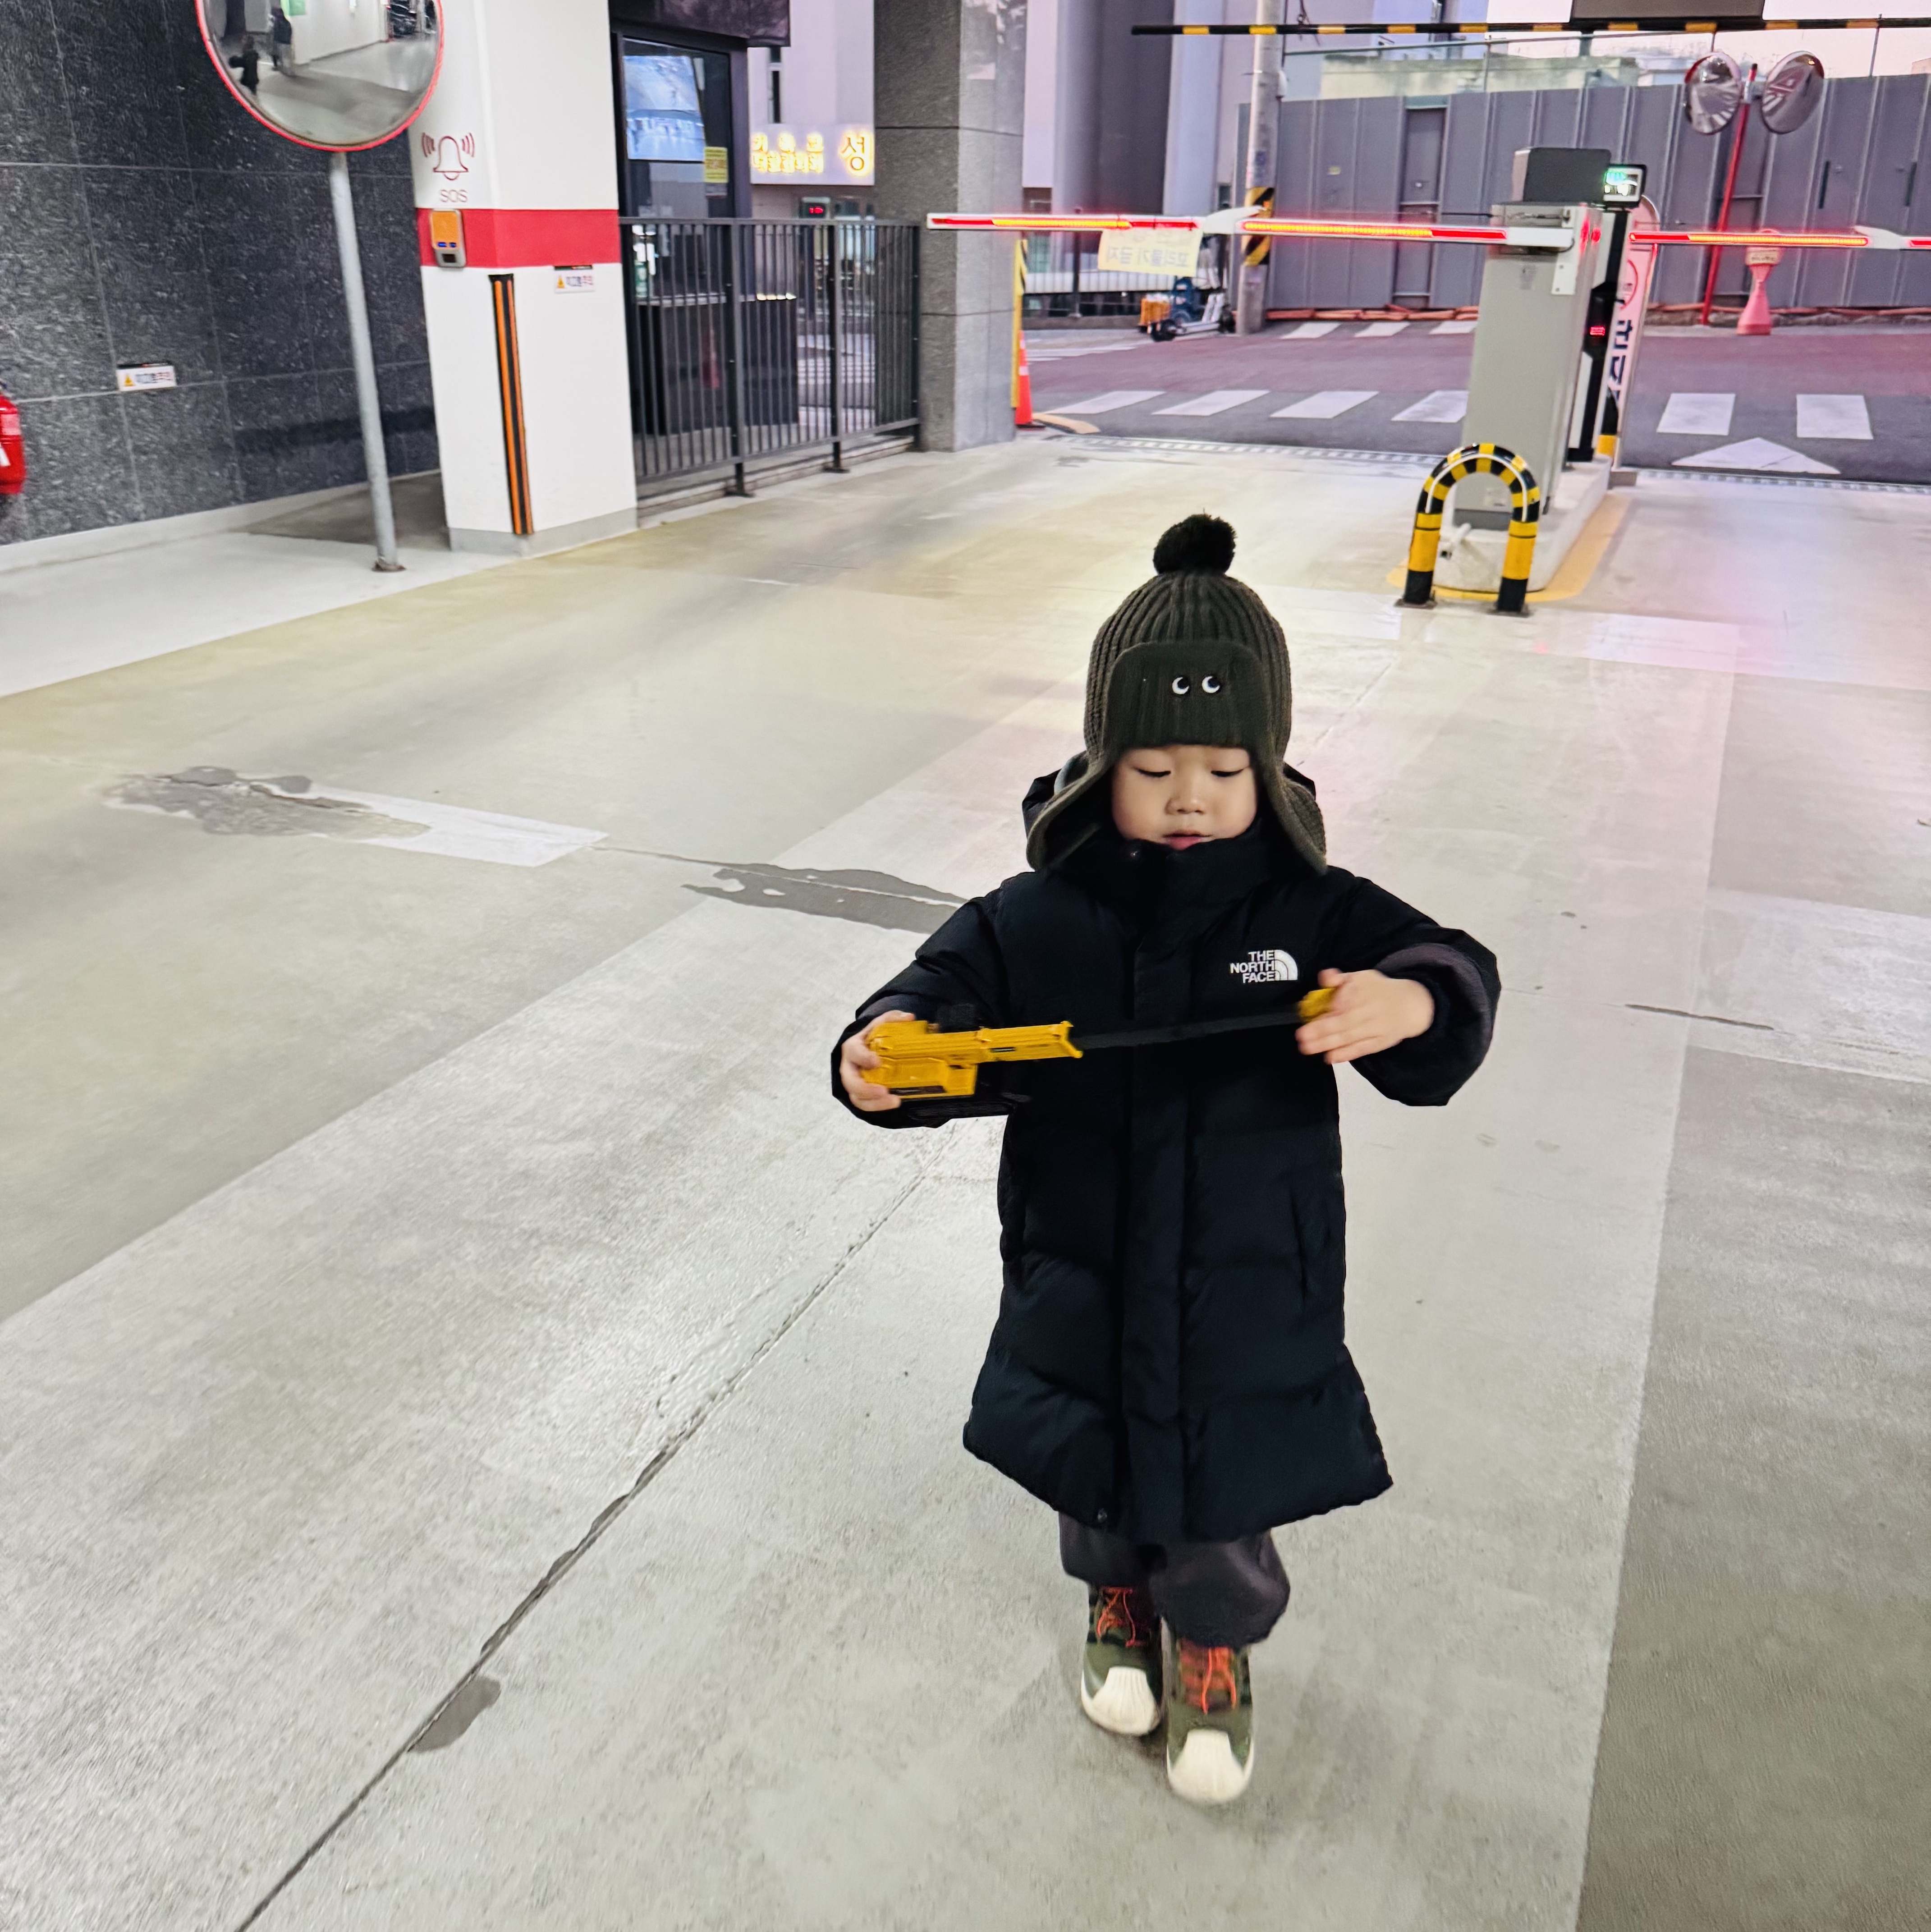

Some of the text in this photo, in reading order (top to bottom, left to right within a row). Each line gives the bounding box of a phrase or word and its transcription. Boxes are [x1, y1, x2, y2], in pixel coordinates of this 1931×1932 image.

[841, 136, 865, 171] 성
[439, 189, 468, 203] SOS
[1248, 950, 1275, 961] THE
[1230, 960, 1275, 973] NORTH
[1243, 971, 1275, 983] FACE
